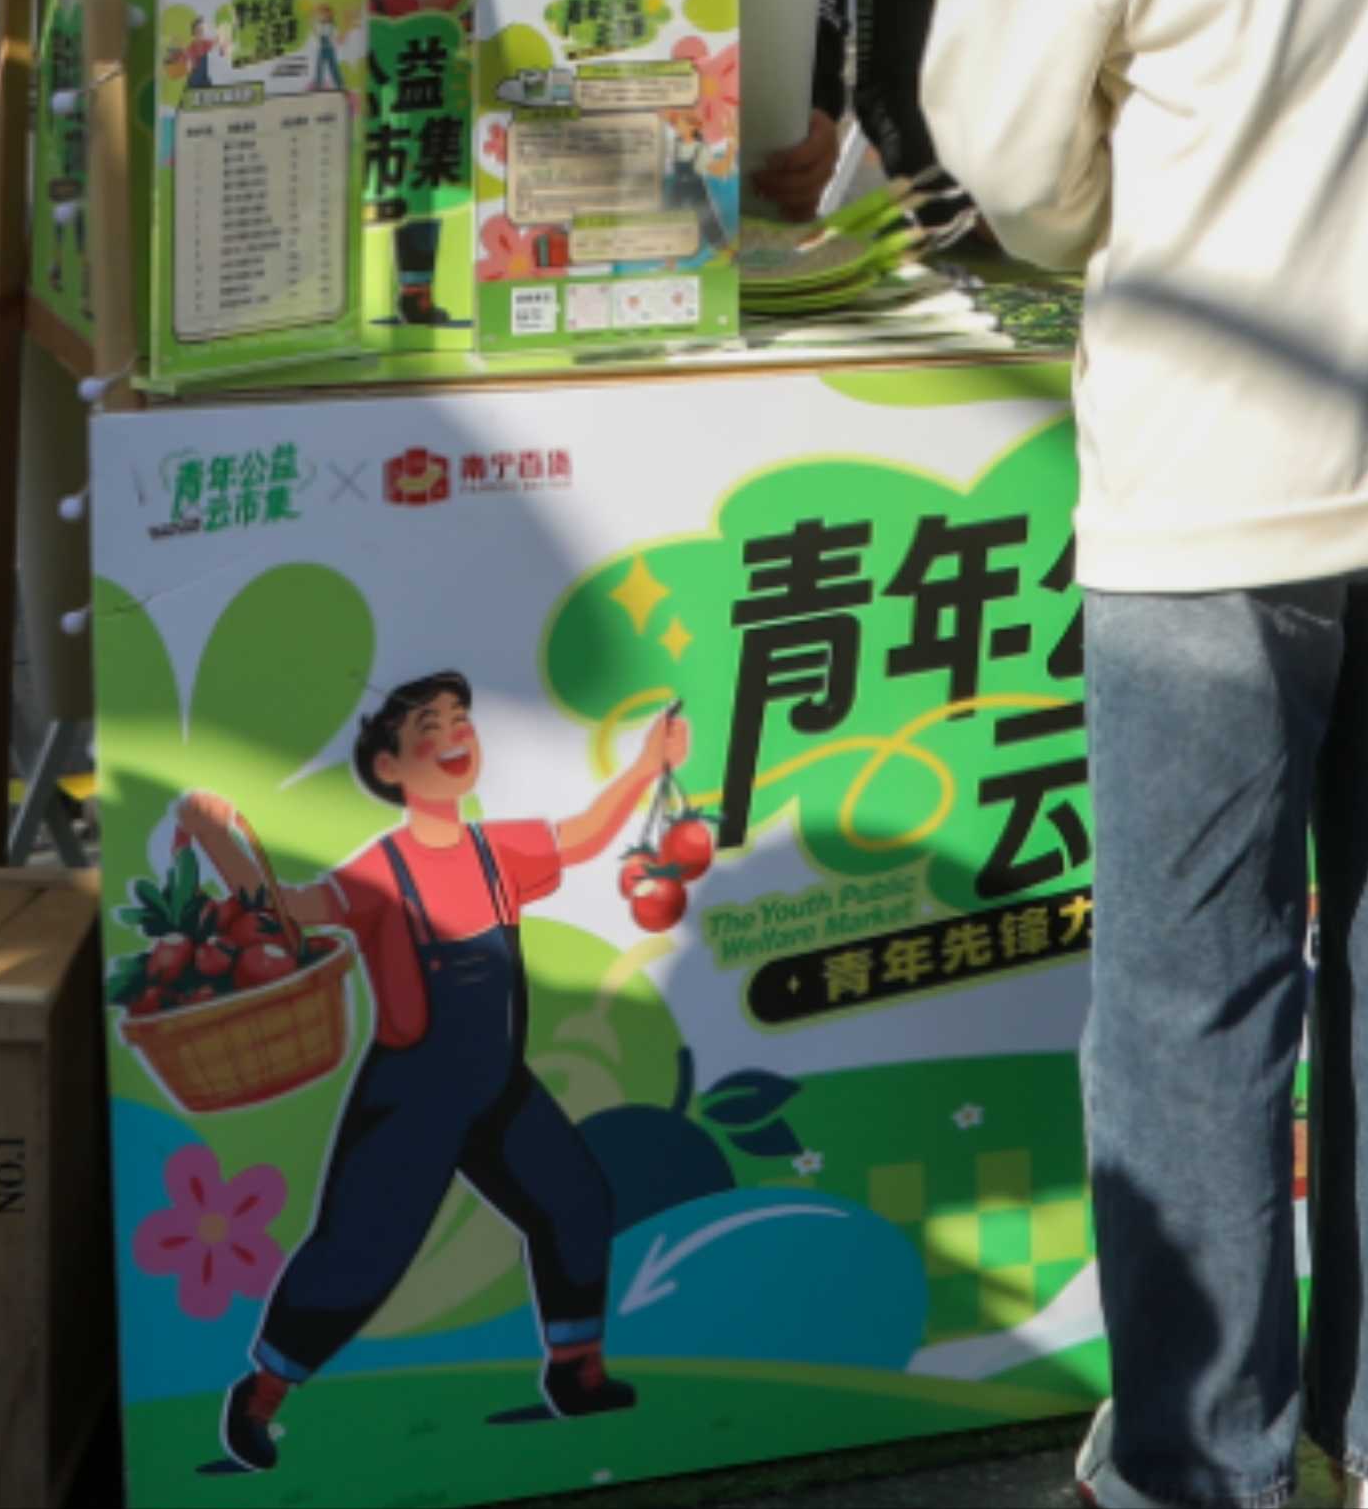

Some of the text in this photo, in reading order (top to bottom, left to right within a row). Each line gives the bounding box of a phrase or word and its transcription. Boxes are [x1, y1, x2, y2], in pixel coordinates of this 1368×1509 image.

[172, 442, 298, 523] 青年公益
[461, 450, 571, 481] 南宁百货
[974, 700, 1091, 898] 云
[710, 875, 915, 936] The Youth Public
[723, 899, 911, 959] Welfare Market
